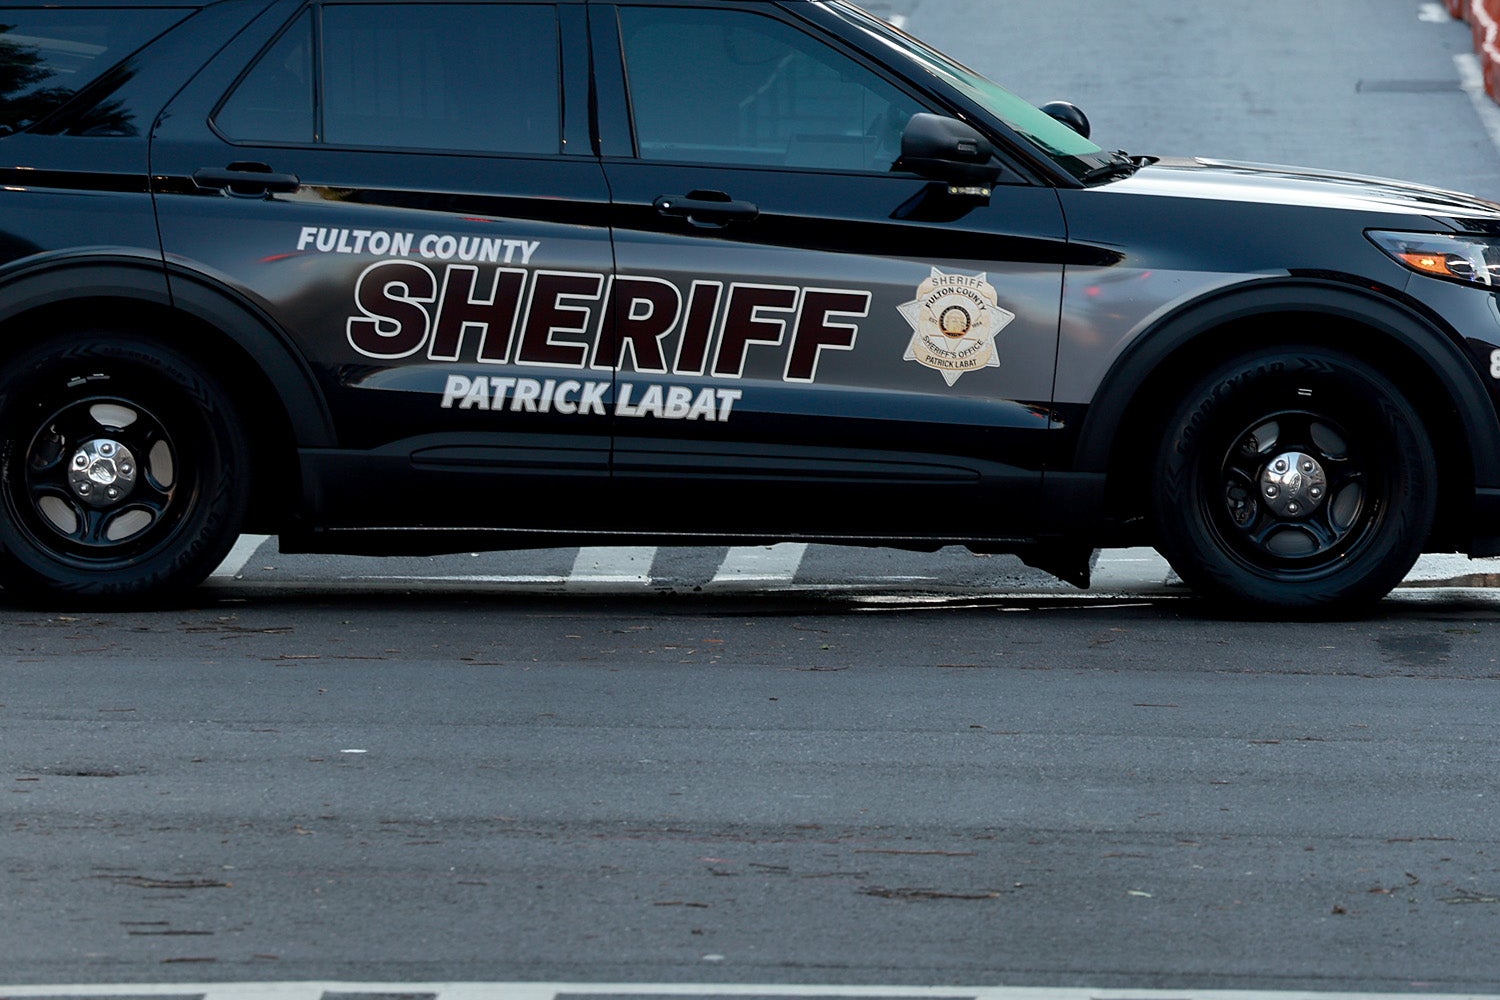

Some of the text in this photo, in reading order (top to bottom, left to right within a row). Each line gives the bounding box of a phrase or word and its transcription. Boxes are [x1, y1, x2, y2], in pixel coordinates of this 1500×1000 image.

[296, 226, 541, 264] FULTON COUNTY
[932, 275, 985, 289] SHERIFF
[925, 287, 987, 311] FULTON COUNTY
[346, 258, 872, 384] SHERIFF
[923, 336, 985, 359] SHERIFF'S OFFICE
[925, 355, 977, 369] PATRICK LABAT
[440, 375, 742, 422] PATRICK LABAT
